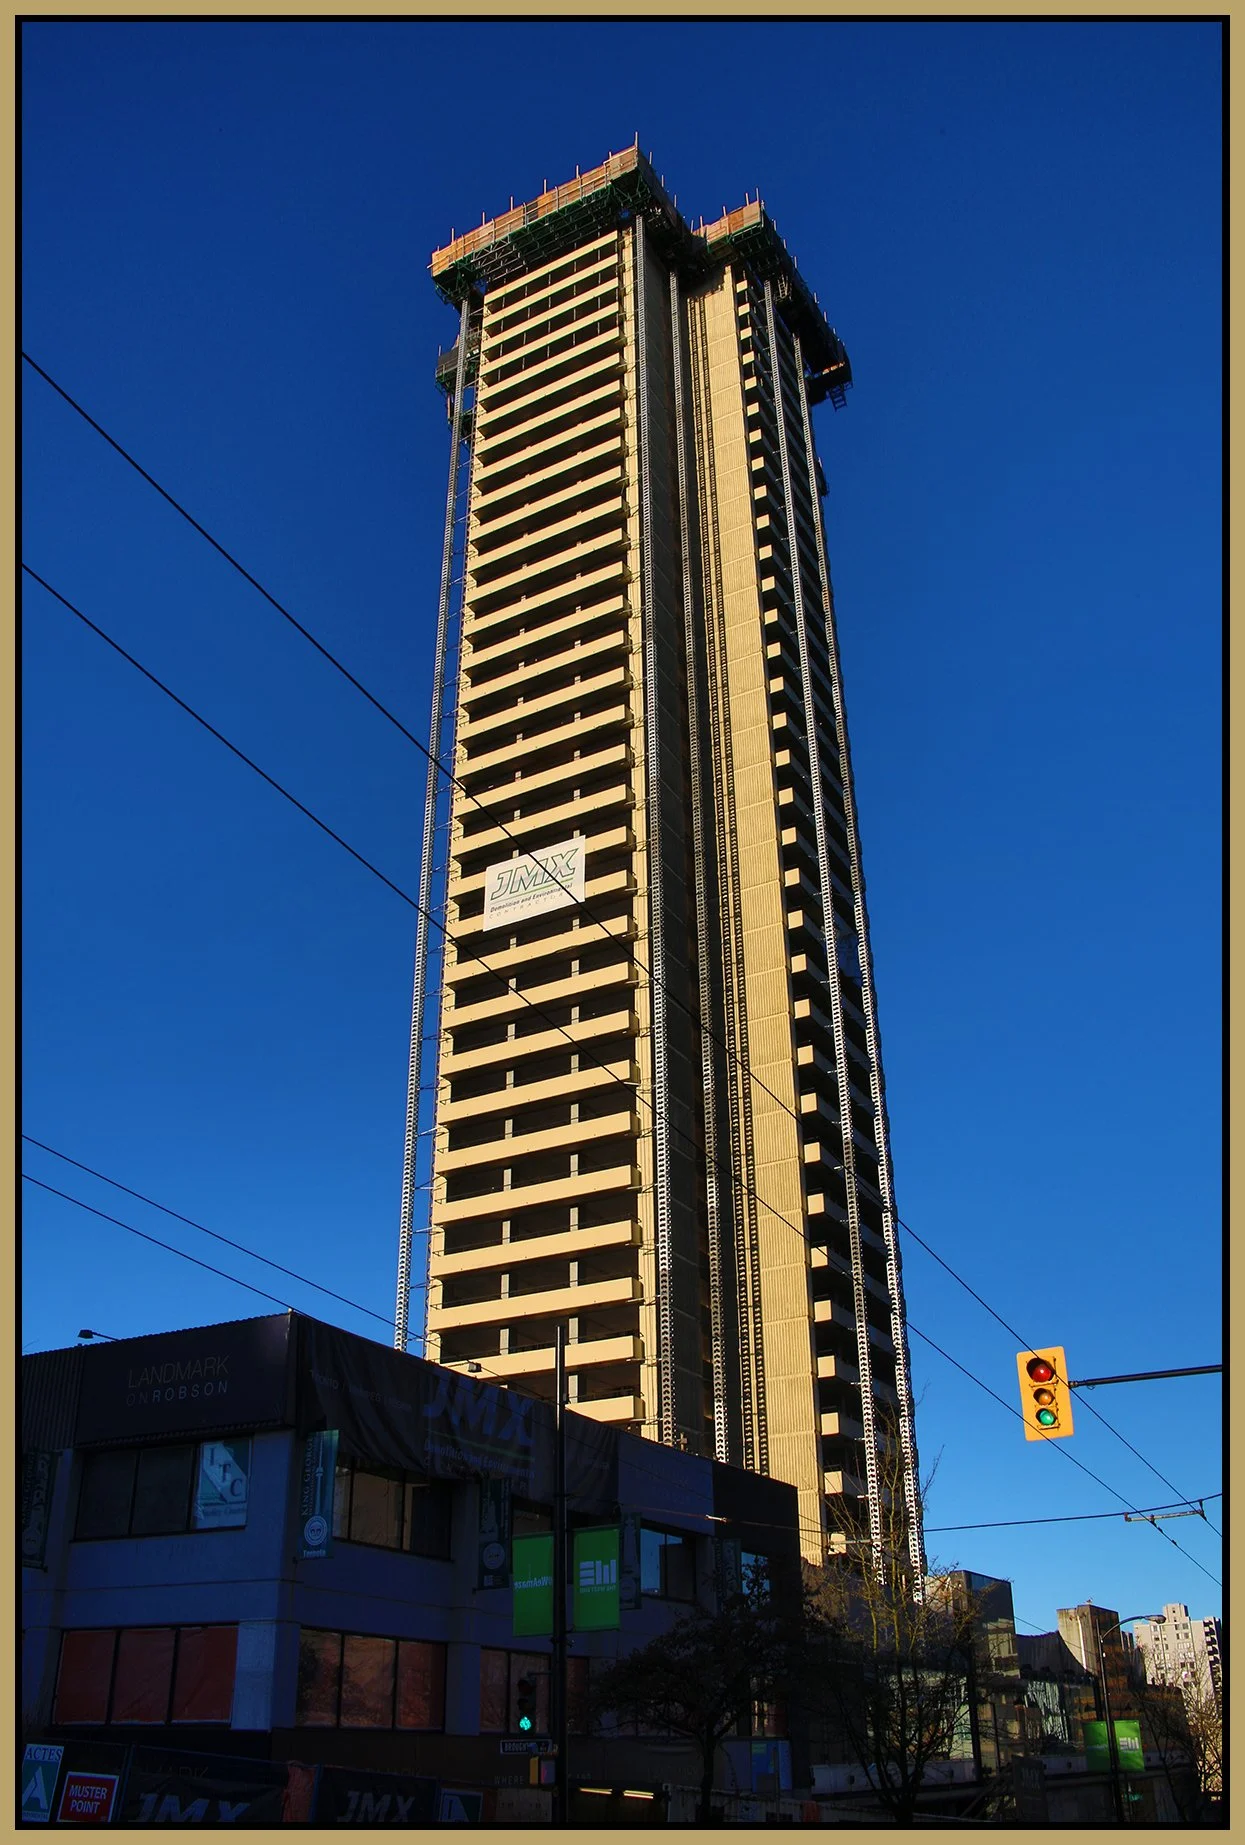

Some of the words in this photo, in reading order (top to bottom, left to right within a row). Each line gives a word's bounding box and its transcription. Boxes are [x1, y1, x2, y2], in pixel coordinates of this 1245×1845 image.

[490, 847, 579, 901] JMX
[489, 891, 569, 919] CONTRACTOR
[490, 899, 520, 913] Demolition
[521, 894, 532, 904] and
[128, 1352, 232, 1389] LANDMARK
[422, 1374, 537, 1446] JMX
[25, 1747, 63, 1761] ACTES
[69, 1784, 109, 1801] MUSTER
[69, 1799, 101, 1814] POINT
